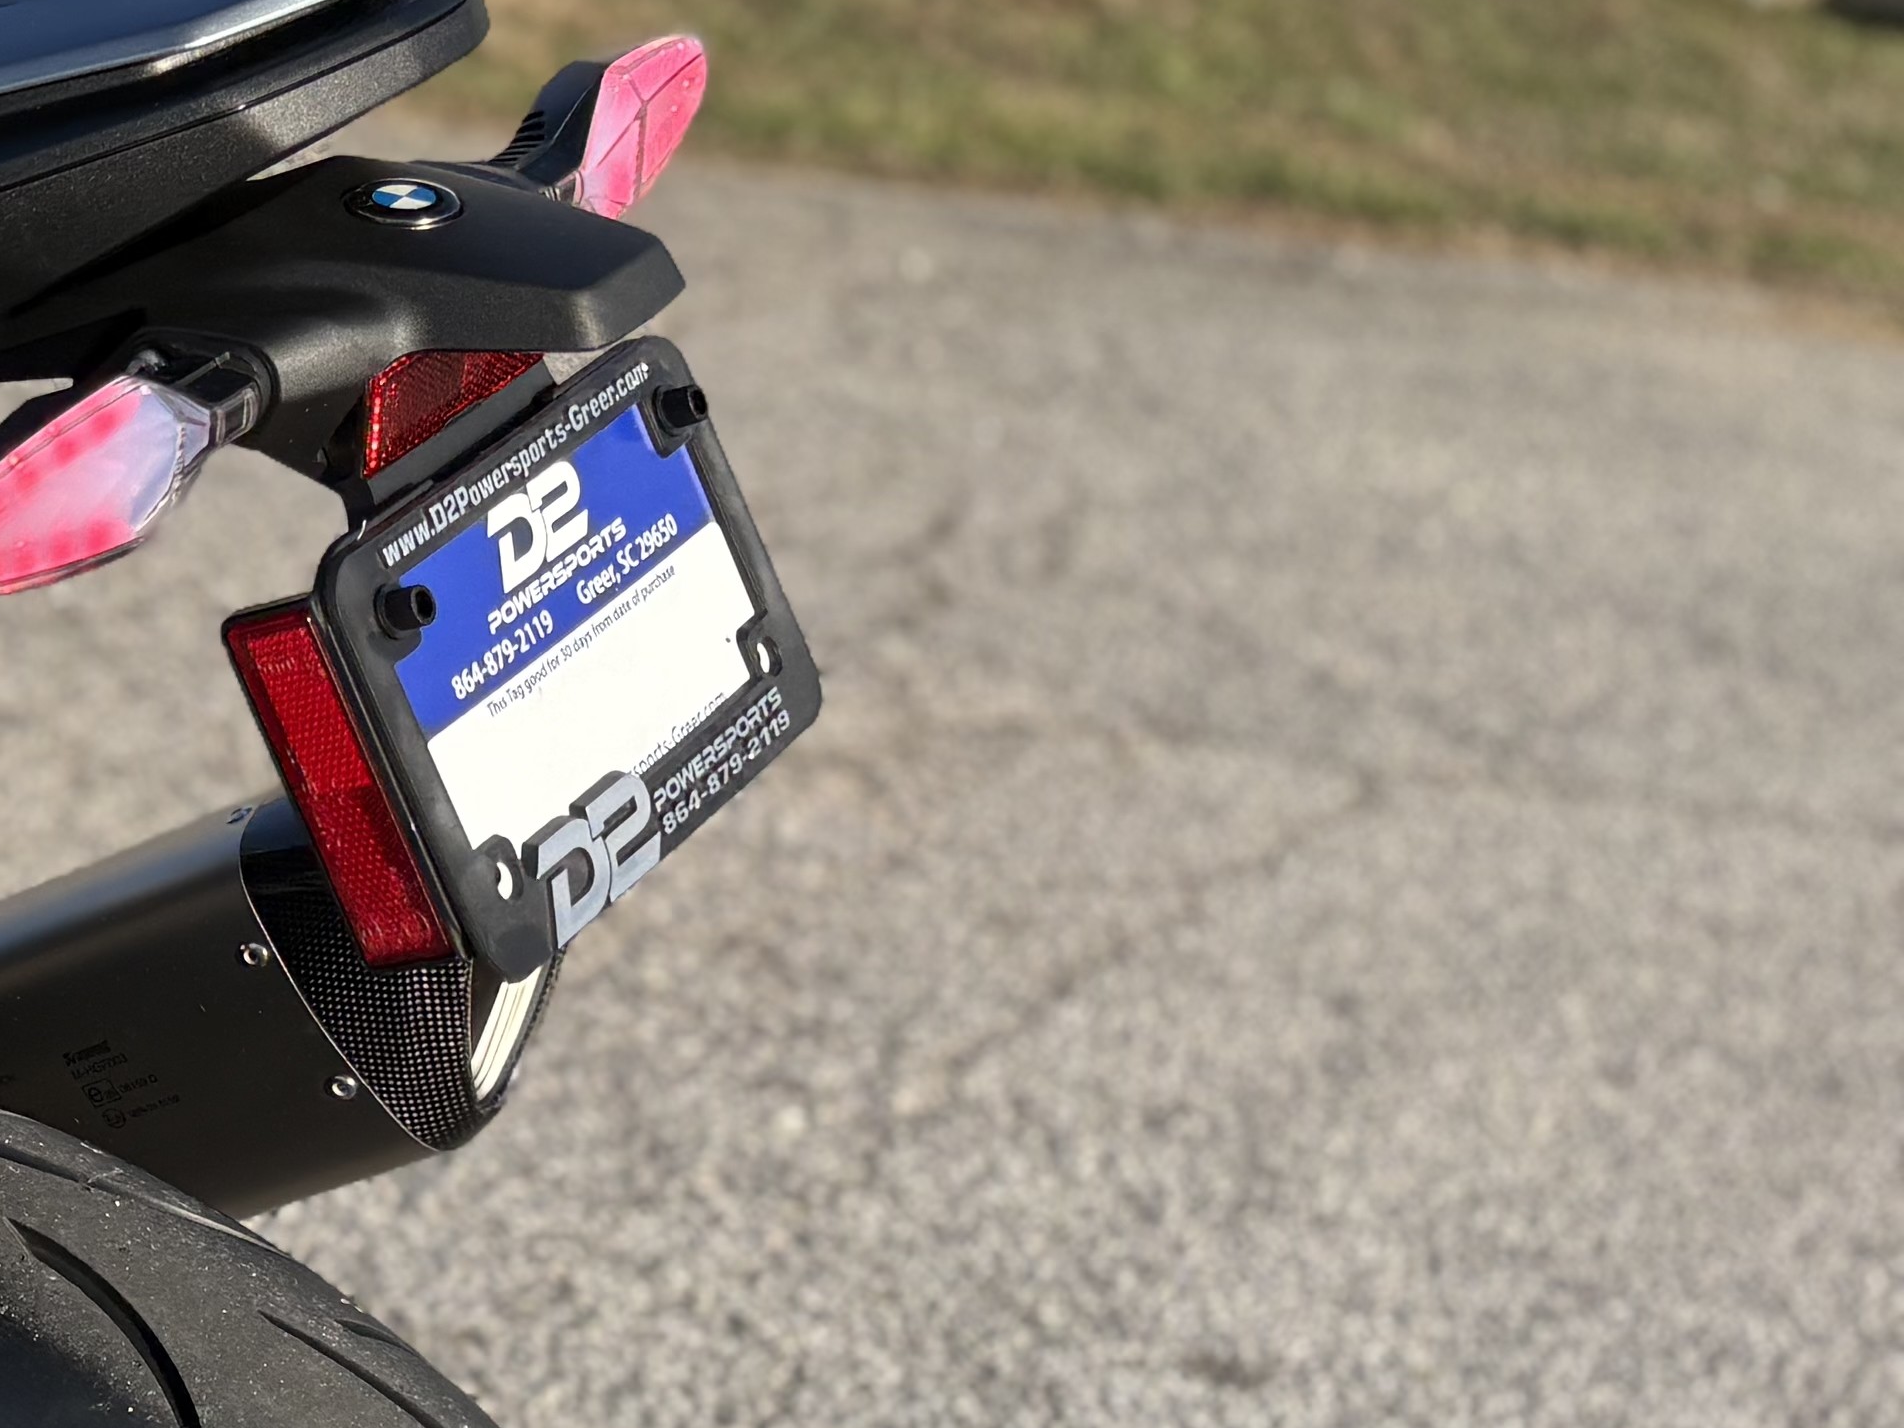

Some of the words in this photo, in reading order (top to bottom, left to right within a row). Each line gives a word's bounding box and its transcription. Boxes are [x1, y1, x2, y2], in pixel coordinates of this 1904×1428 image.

[382, 361, 649, 568] www.D2Powersports-Greer.com
[486, 460, 590, 594] D2
[486, 516, 628, 635] POWERSPORTS
[576, 563, 622, 605] Greer,
[615, 543, 641, 576] SC
[635, 512, 679, 562] 29650
[450, 609, 555, 700] 864-879-2119
[486, 696, 509, 718] This
[524, 663, 548, 693] good
[546, 652, 561, 676] for
[572, 630, 594, 654] days
[592, 615, 614, 639] from
[613, 599, 632, 623] date
[630, 587, 642, 607] of
[640, 563, 676, 602] purchase
[653, 685, 783, 813] POWERSPORTS
[661, 708, 791, 835] 864-879-2119
[536, 770, 661, 949] D2
